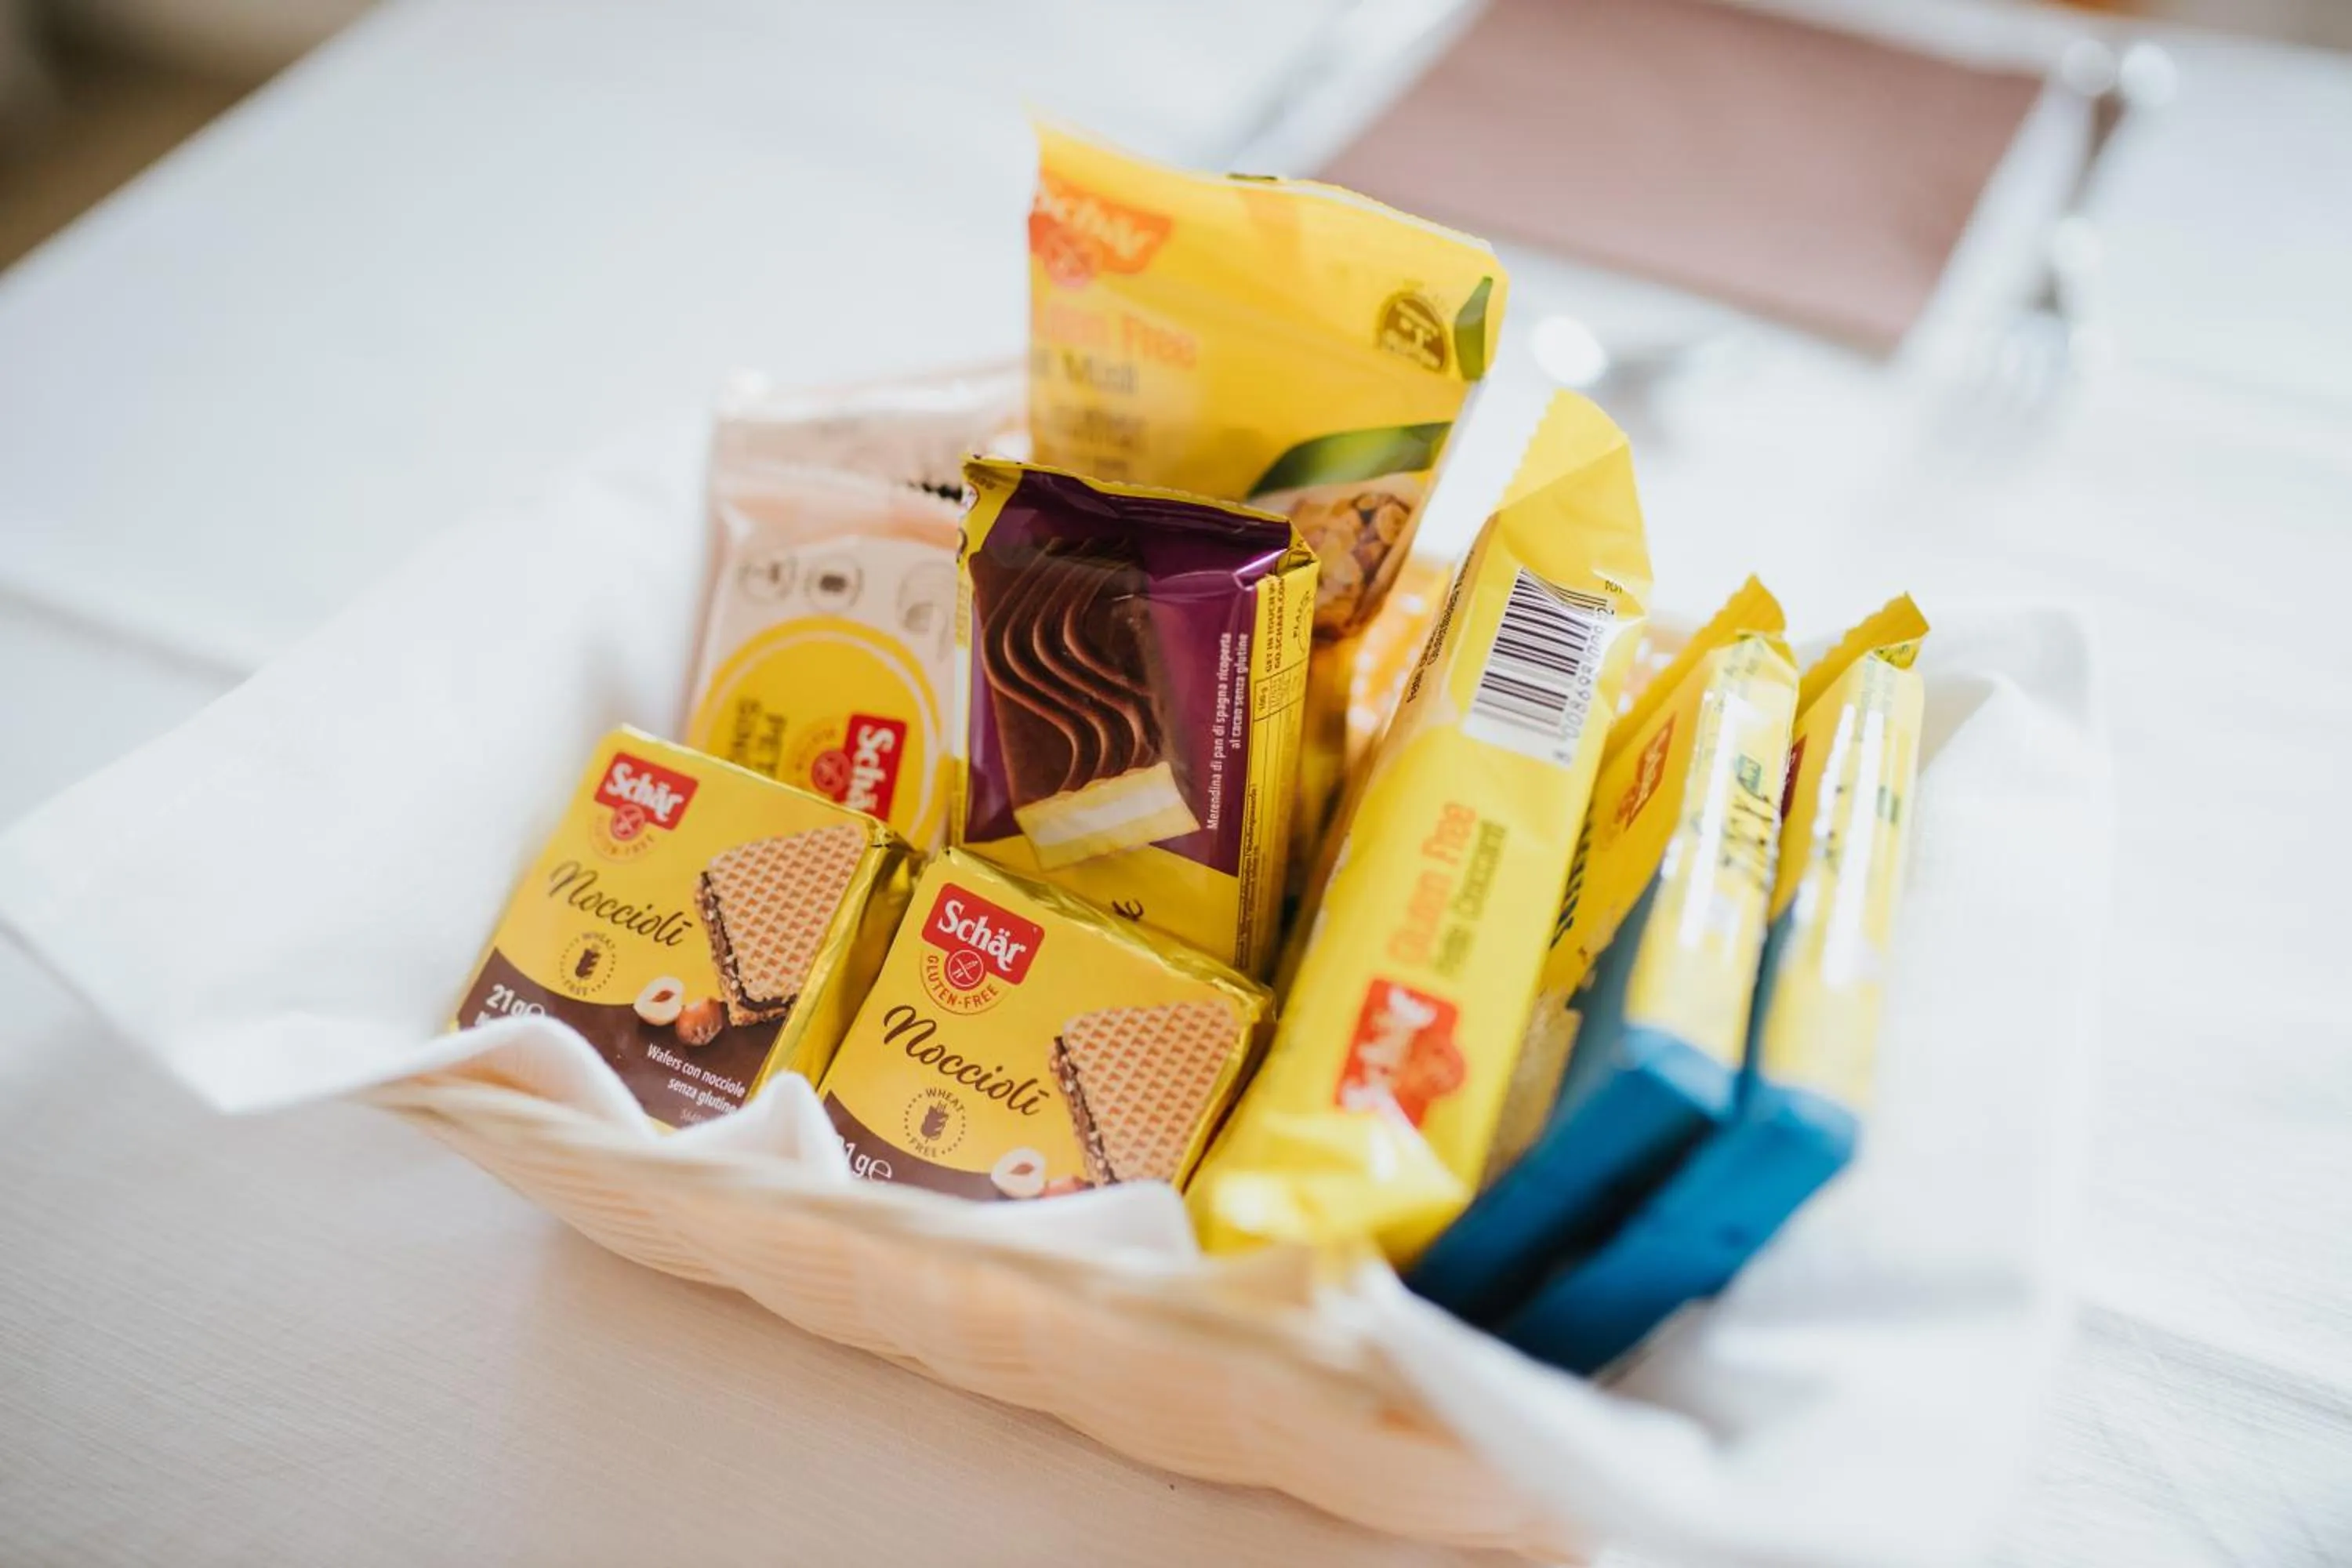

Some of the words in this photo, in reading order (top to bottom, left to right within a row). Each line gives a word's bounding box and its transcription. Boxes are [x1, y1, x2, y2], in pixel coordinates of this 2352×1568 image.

[1217, 633, 1232, 681] ricoperta
[1234, 633, 1248, 673] glutine
[1216, 684, 1230, 723] spagna
[1234, 676, 1245, 706] senza
[1212, 725, 1225, 736] di
[1232, 708, 1243, 736] cacao
[1214, 738, 1226, 758] pan
[1229, 739, 1241, 750] al
[845, 724, 896, 812] Schä
[1210, 760, 1223, 771] di
[605, 762, 684, 822] Schär
[1207, 773, 1222, 829] Merendina
[938, 899, 1026, 972] Schär
[926, 954, 1000, 1010] GLUTEN-FREE
[647, 1043, 682, 1071] Wafers
[682, 1062, 702, 1079] con
[702, 1070, 746, 1098] nocciole
[668, 1078, 698, 1100] senza
[925, 1087, 966, 1112] WHEAT
